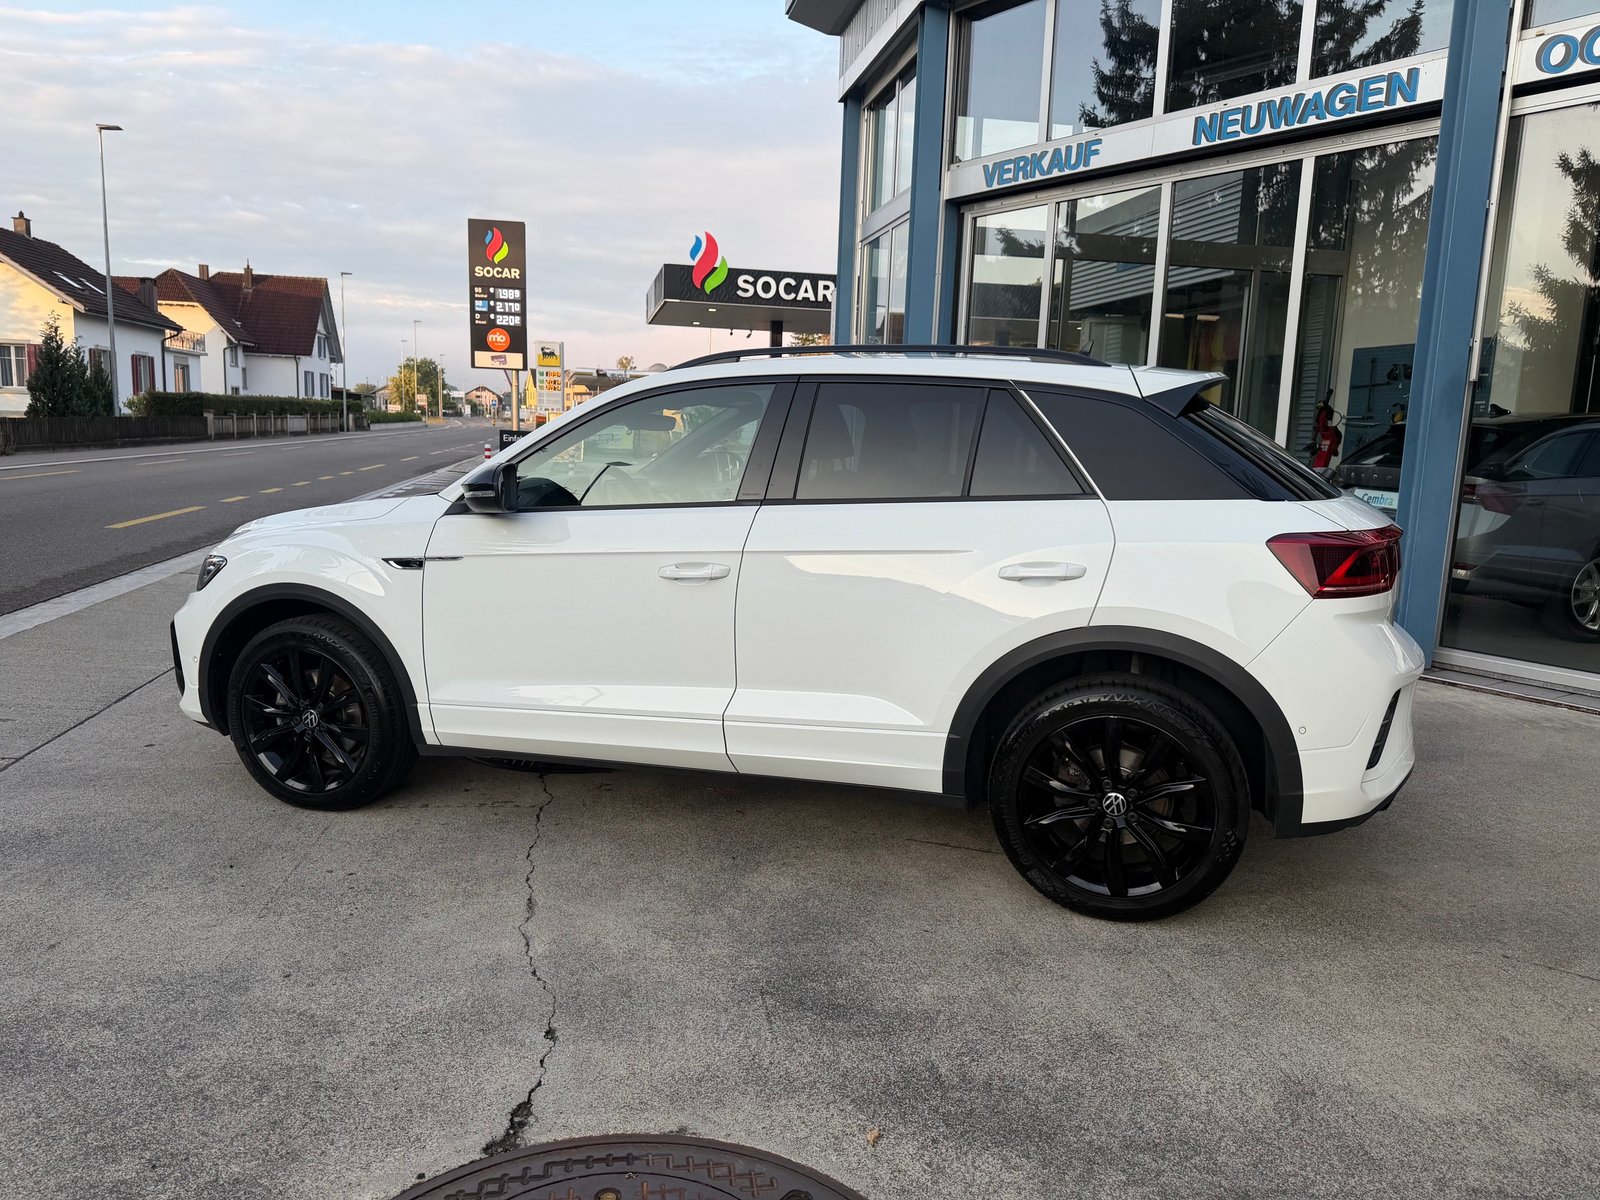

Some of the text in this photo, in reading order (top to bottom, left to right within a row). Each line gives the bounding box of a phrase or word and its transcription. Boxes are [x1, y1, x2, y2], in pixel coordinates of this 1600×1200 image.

[1192, 67, 1420, 146] NEUWAGEN
[983, 138, 1102, 188] VERKAUF
[474, 265, 520, 279] SOCAR
[736, 274, 835, 302] SOCAR
[489, 332, 506, 343] mio
[1361, 493, 1394, 506] Cembra
